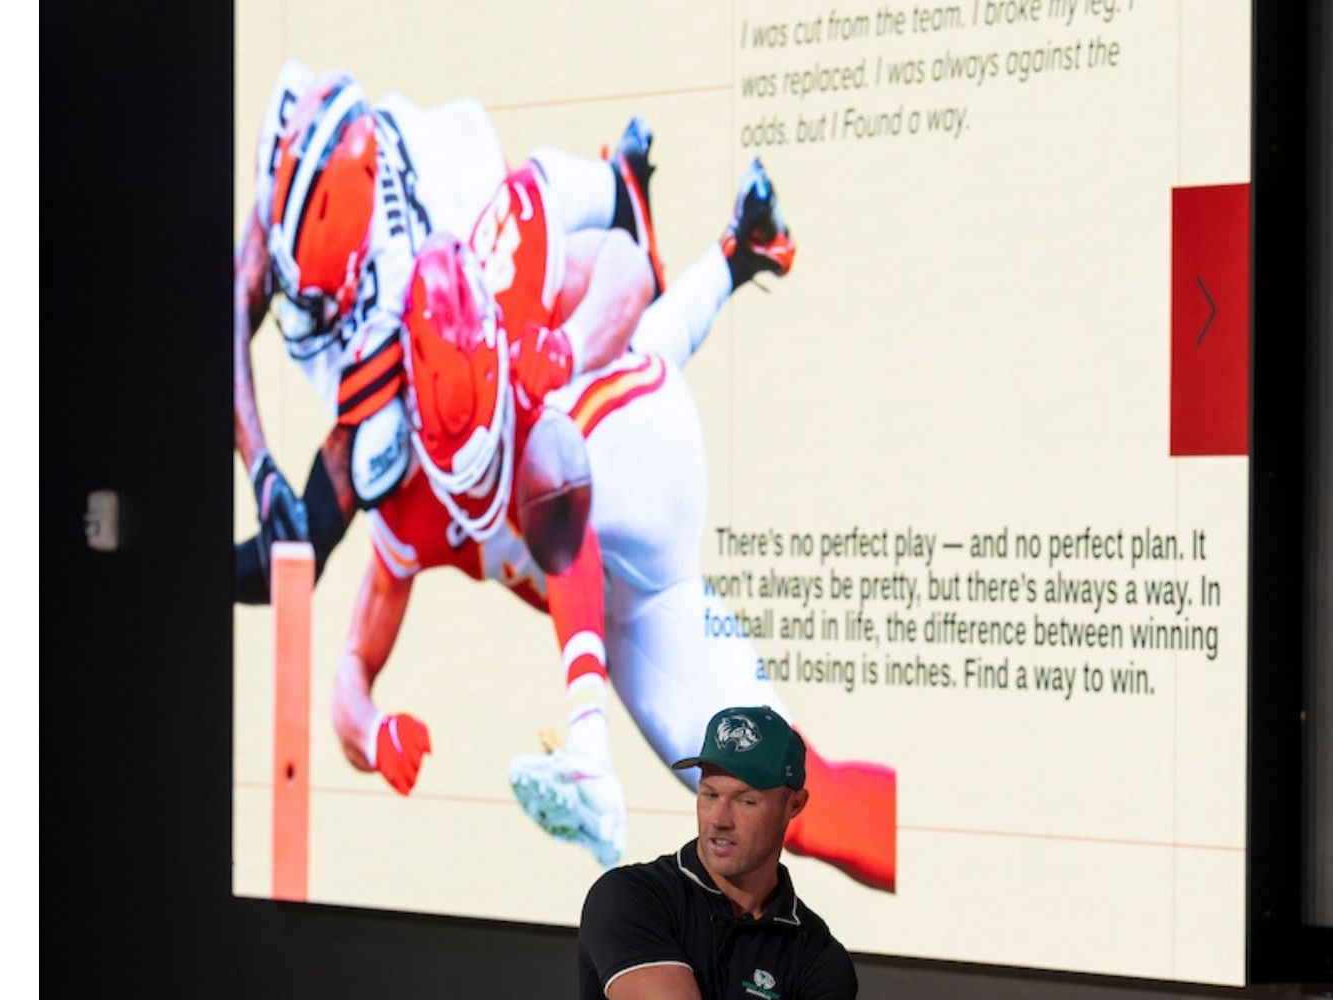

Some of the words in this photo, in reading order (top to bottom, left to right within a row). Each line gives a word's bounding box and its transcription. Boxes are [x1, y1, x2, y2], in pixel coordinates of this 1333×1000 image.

[751, 24, 788, 48] was
[794, 15, 824, 44] cut
[827, 9, 870, 41] from
[875, 6, 905, 37] the
[912, 5, 965, 34] team.
[984, 0, 1042, 26] broke
[1048, 0, 1076, 26] my
[741, 73, 776, 98] was
[783, 58, 869, 100] replaced.
[887, 59, 925, 84] was
[931, 48, 999, 87] always
[1005, 38, 1083, 83] against
[1087, 35, 1121, 68] the
[795, 112, 827, 143] but
[843, 104, 904, 139] Found
[908, 110, 921, 135] a
[927, 106, 970, 140] way.
[715, 526, 783, 557] There's
[789, 532, 814, 557] no
[820, 525, 888, 565] perfect
[894, 525, 937, 567] play
[970, 525, 1008, 558] and
[1015, 532, 1041, 559] no
[1049, 526, 1124, 568] perfect
[1131, 526, 1185, 569] plan.
[1192, 528, 1207, 560] It
[703, 570, 753, 598] won't
[758, 567, 824, 607] always
[830, 568, 854, 600] be
[860, 572, 921, 609] pretty,
[928, 569, 960, 601] but
[967, 569, 1037, 602] there's
[1044, 570, 1118, 613] always
[1125, 579, 1138, 605] a
[1144, 579, 1193, 615] way.
[1200, 574, 1221, 606] In
[704, 608, 774, 639] football
[779, 609, 815, 640] and
[821, 609, 839, 640] in
[844, 609, 881, 649] life,
[886, 610, 917, 642] the
[923, 610, 1027, 645] difference
[1034, 613, 1123, 648] between
[1129, 616, 1219, 661] winning
[755, 651, 790, 682] and
[796, 652, 855, 693] losing
[862, 653, 879, 685] is
[885, 653, 957, 687] inches.
[964, 656, 1009, 690] Find
[1015, 665, 1028, 690] a
[1033, 665, 1076, 700] way
[1083, 661, 1104, 693] to
[1110, 661, 1155, 694] win.
